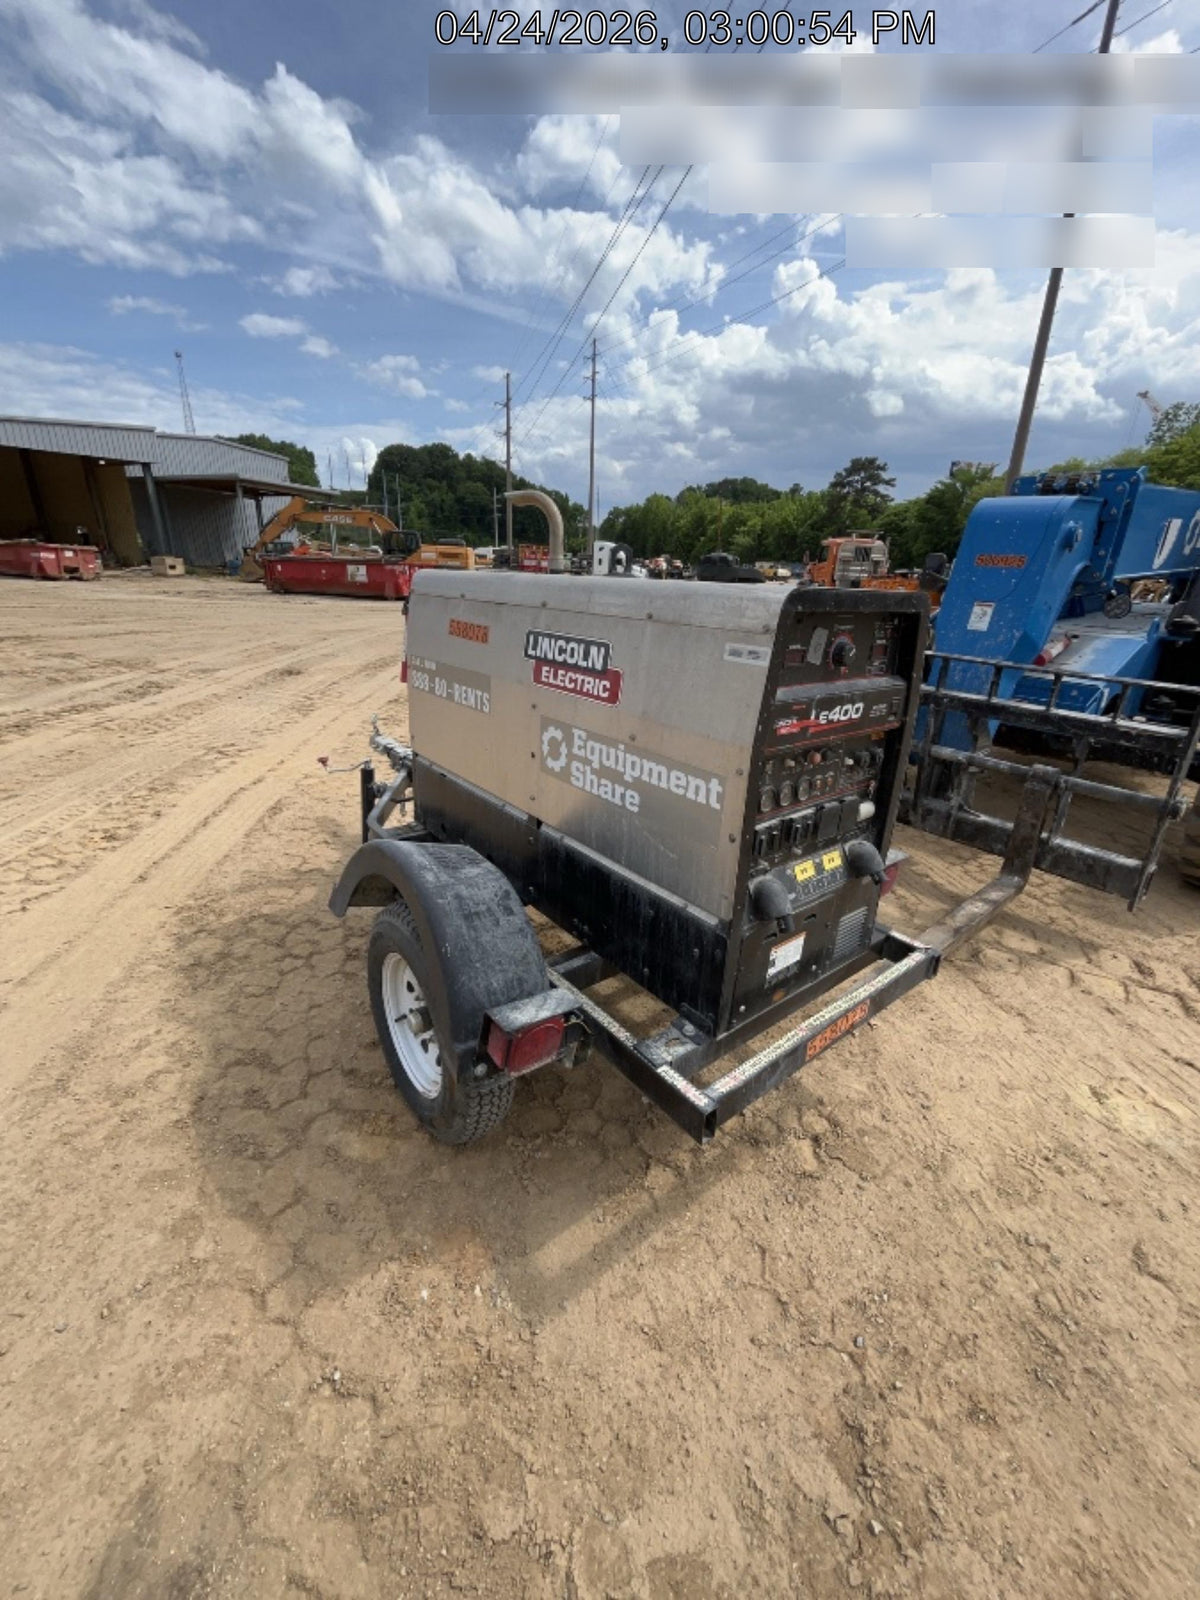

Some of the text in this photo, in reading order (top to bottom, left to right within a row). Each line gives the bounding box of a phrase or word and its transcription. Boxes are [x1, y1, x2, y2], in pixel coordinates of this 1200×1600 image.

[526, 633, 606, 671] LINCOLN
[541, 665, 611, 698] ELECTRIC
[570, 760, 641, 813] Share
[572, 727, 724, 811] Equipment
